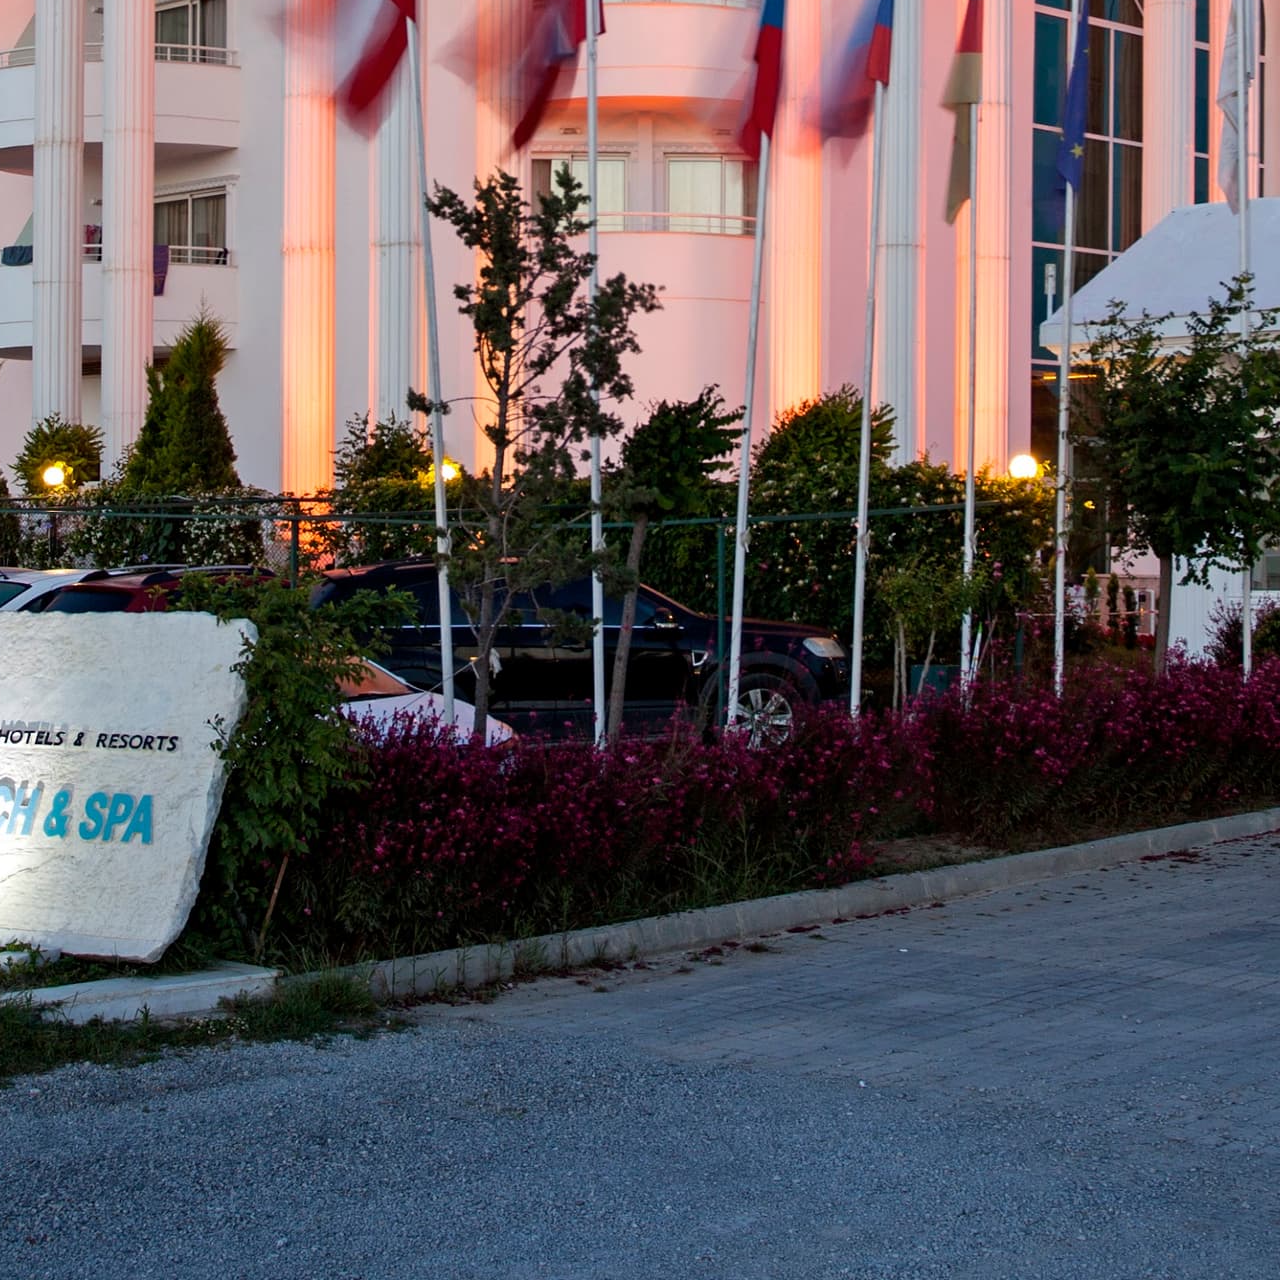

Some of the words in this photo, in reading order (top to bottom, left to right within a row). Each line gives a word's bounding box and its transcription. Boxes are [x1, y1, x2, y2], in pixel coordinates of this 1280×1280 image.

[73, 732, 85, 747] &
[95, 733, 179, 752] RESORTS
[43, 789, 70, 839] &
[78, 791, 153, 846] SPA
